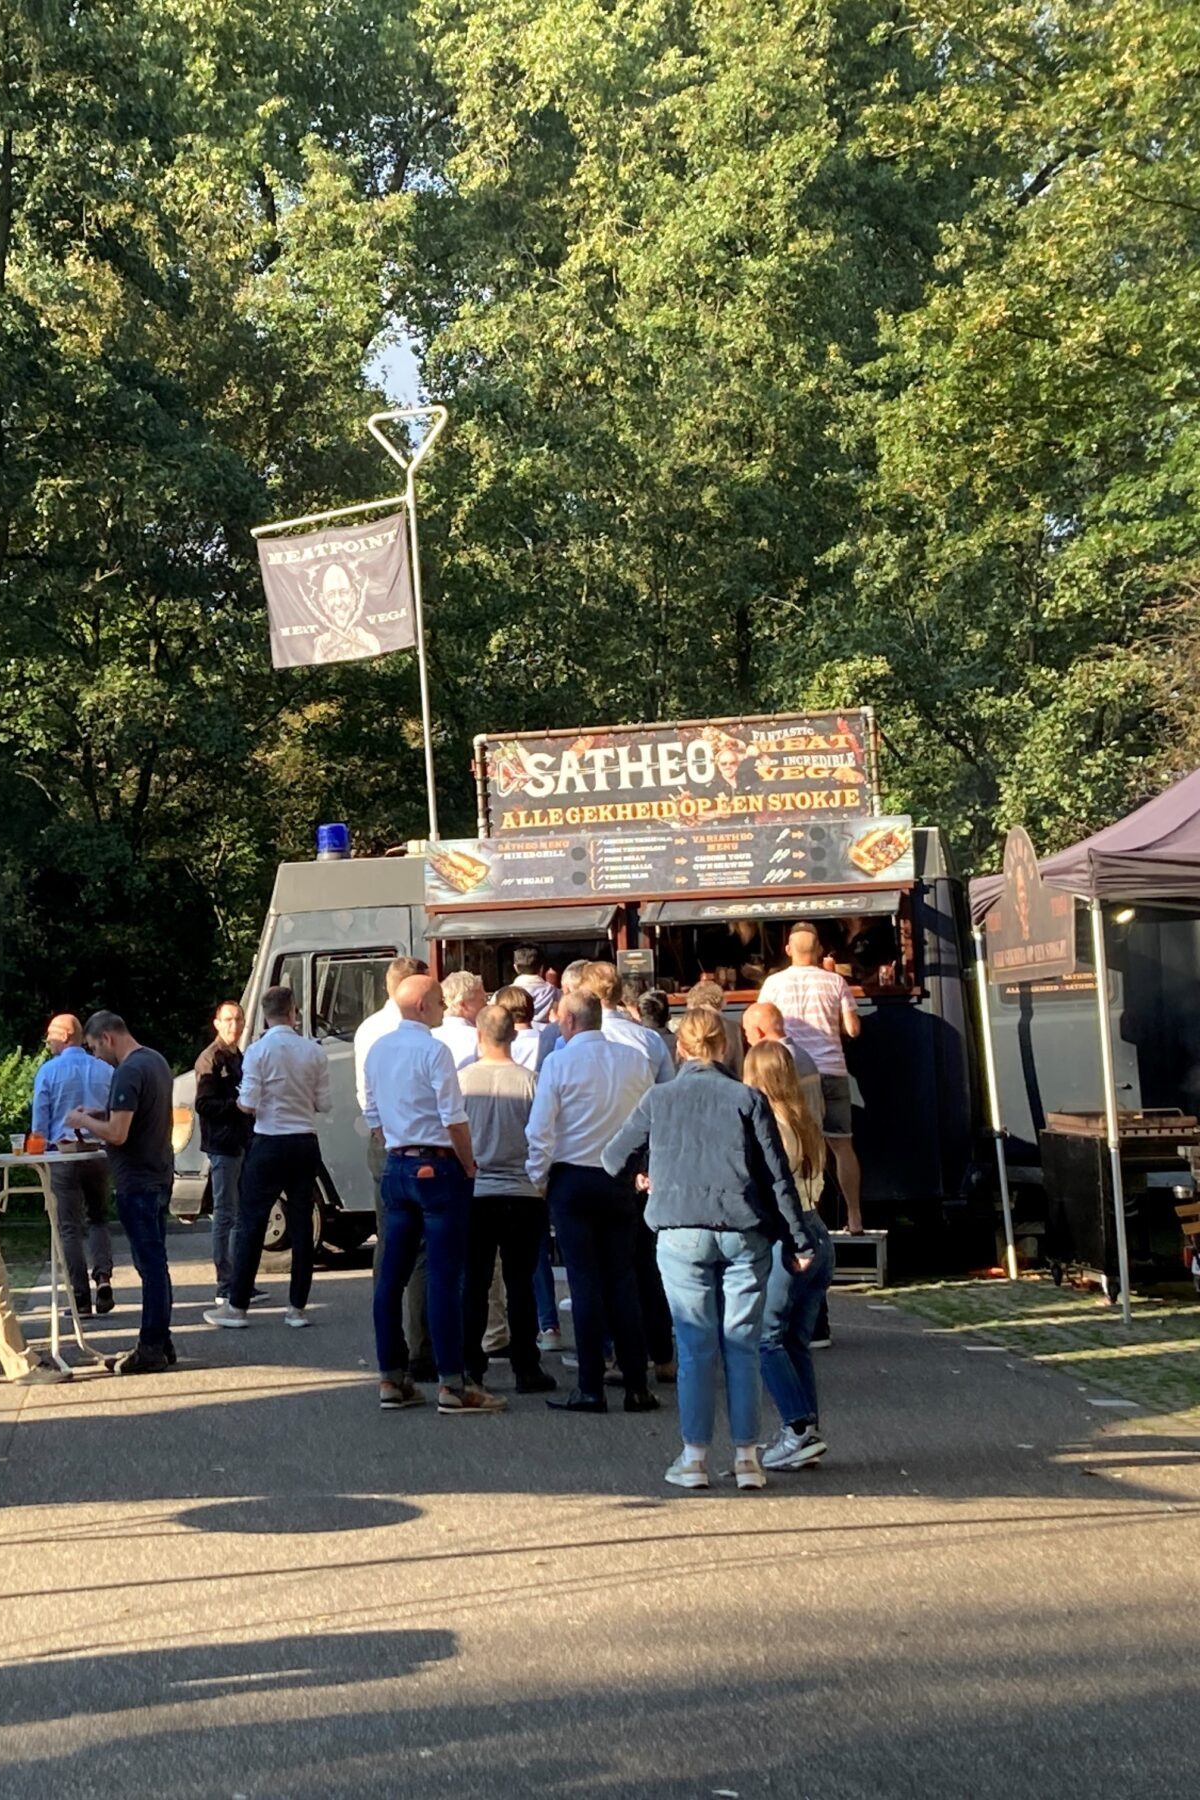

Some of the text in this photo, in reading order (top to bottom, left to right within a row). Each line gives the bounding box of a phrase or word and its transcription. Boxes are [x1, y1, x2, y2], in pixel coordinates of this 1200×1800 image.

[267, 529, 398, 566] MEATPOINT
[366, 607, 408, 625] VEGA
[280, 624, 320, 637] MEAT
[751, 726, 815, 742] FANTASTIC
[750, 734, 855, 753] MEAT
[782, 751, 856, 768] INCREDIBLE
[521, 739, 716, 799] SATHEO
[754, 765, 860, 782] VEGA
[501, 808, 564, 830] ALLE
[565, 800, 677, 825] GEKHEID
[679, 798, 712, 817] OP
[768, 788, 860, 811] STOKJE
